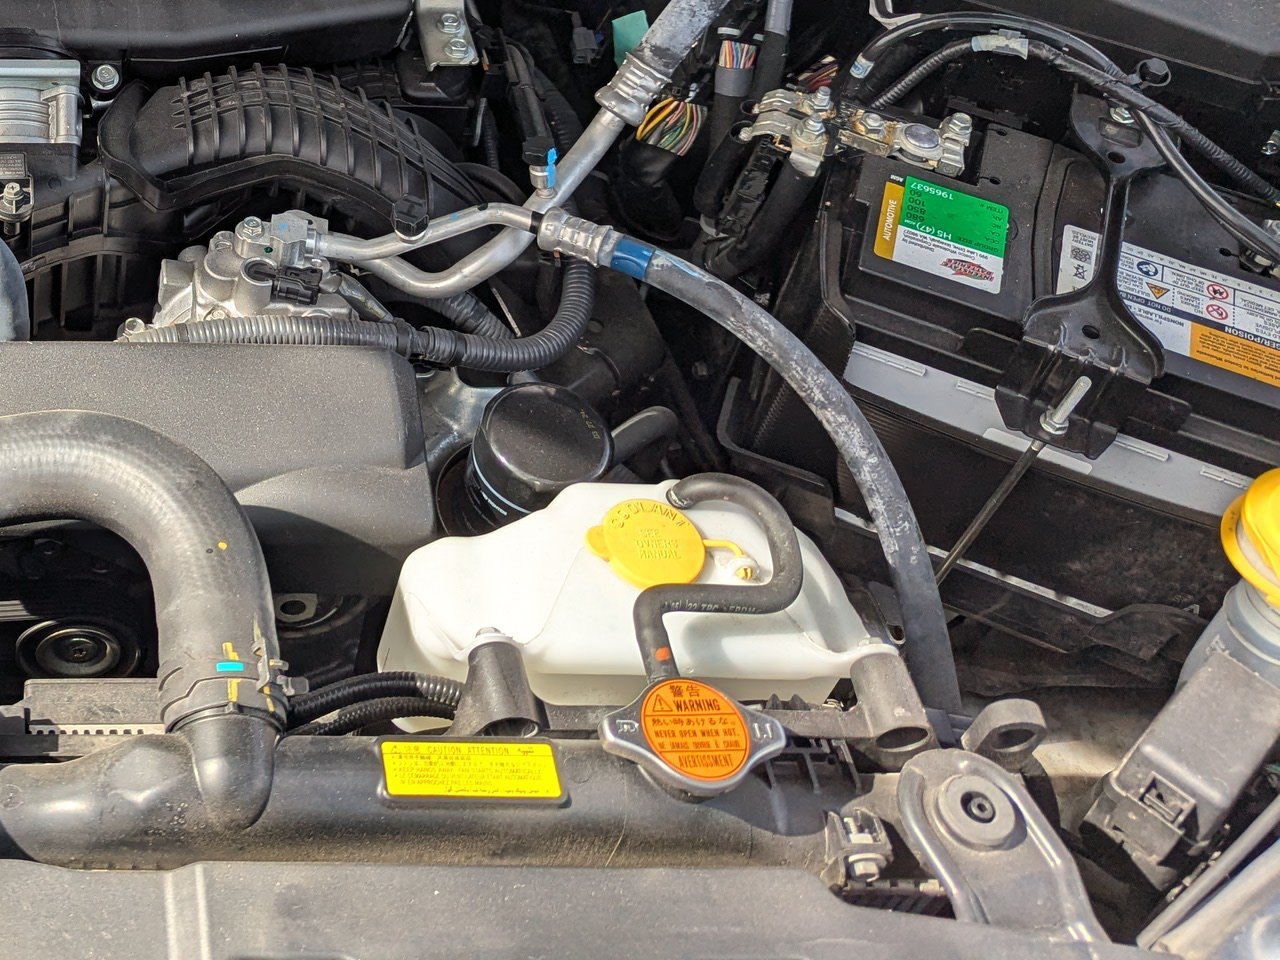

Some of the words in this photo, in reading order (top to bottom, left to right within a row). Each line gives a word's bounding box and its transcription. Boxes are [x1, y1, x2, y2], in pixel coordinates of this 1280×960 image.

[909, 189, 922, 198] 60
[910, 181, 953, 201] 1965637
[908, 196, 926, 207] 100
[907, 204, 926, 215] 850
[882, 199, 897, 241] AUTOMOTIVE
[905, 211, 925, 223] 680
[916, 221, 935, 235] (47)
[937, 229, 952, 240] H5
[939, 261, 994, 282] INTERSTATE
[1128, 294, 1145, 304] OPEN
[1147, 301, 1160, 309] NOT
[611, 502, 690, 528] COOLANT
[639, 549, 681, 560] MANUAL
[670, 685, 700, 697] 警告
[673, 699, 720, 712] WARNING
[654, 730, 676, 738] NEVER
[679, 729, 697, 737] OPEN
[723, 728, 740, 737] HOT.
[427, 746, 462, 755] CAUTION
[467, 746, 510, 755] ATTENTION
